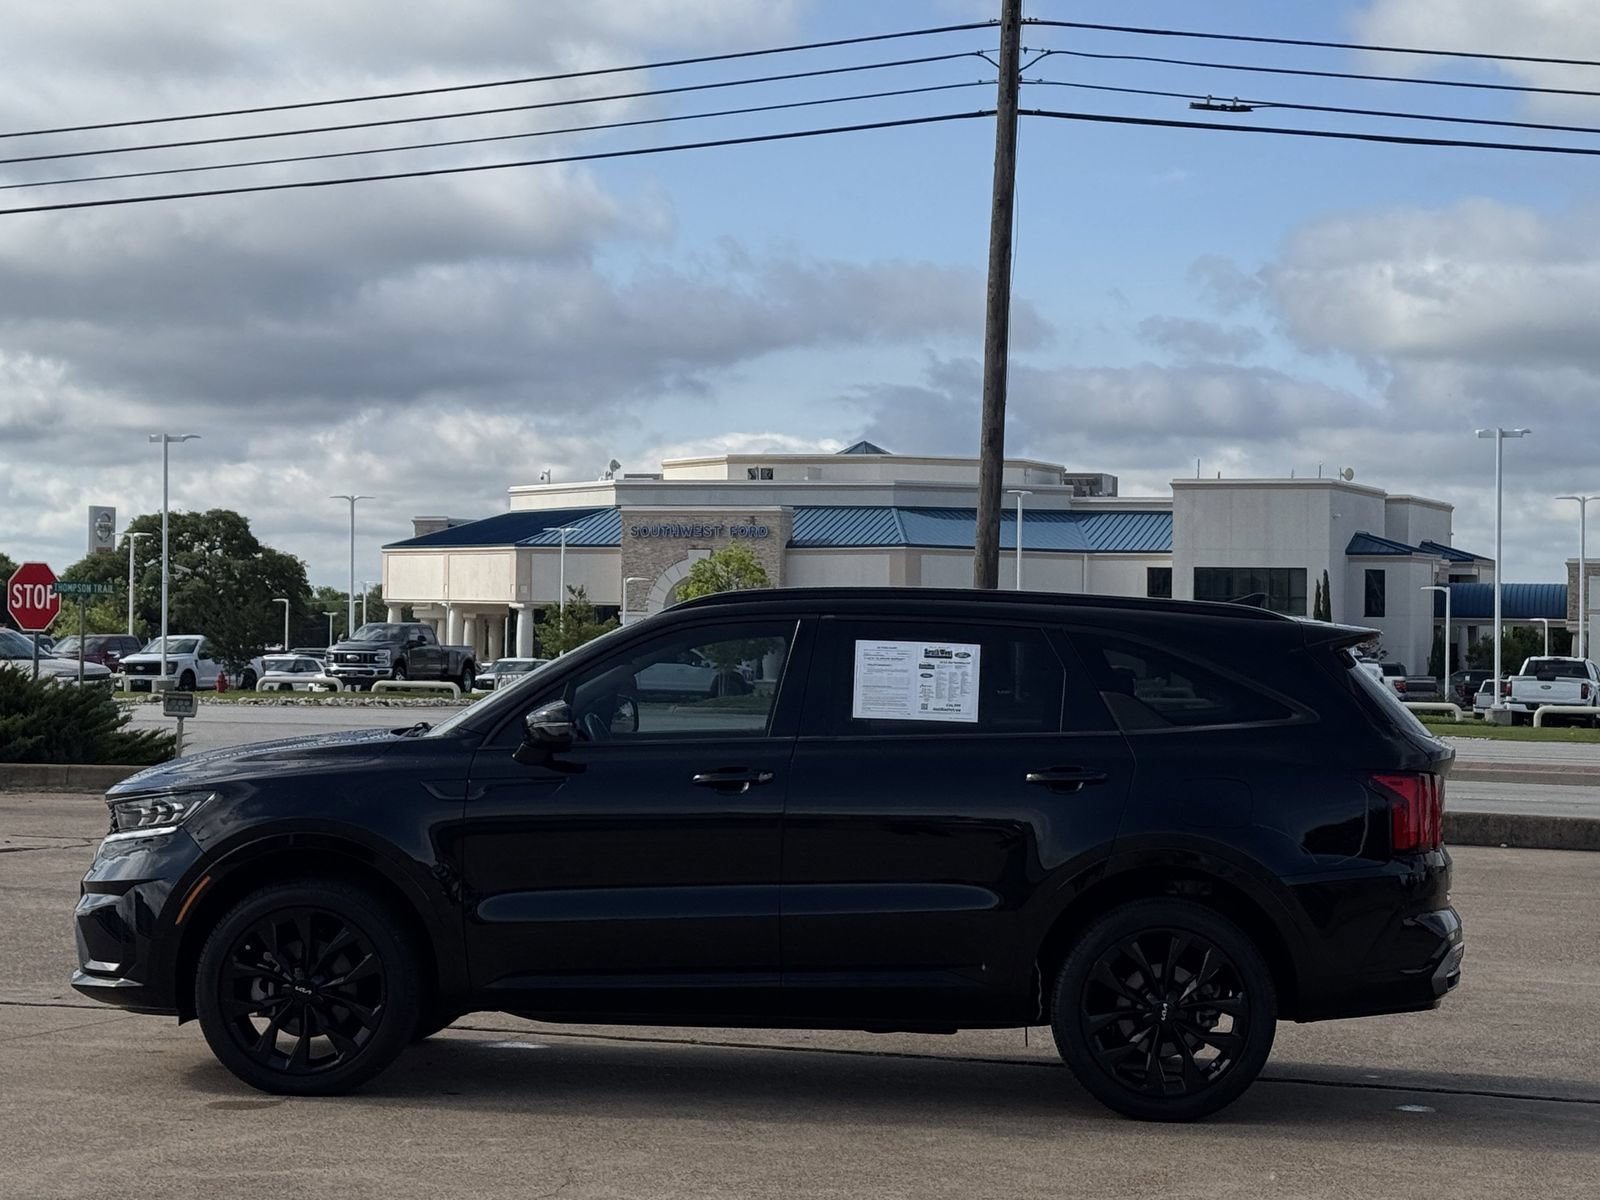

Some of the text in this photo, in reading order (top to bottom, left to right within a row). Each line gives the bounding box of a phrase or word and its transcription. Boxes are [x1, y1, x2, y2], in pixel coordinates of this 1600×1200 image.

[630, 525, 769, 537] SOUTHWEST FORD
[54, 583, 114, 593] THOMPSON TRAIL
[11, 584, 57, 609] STOP
